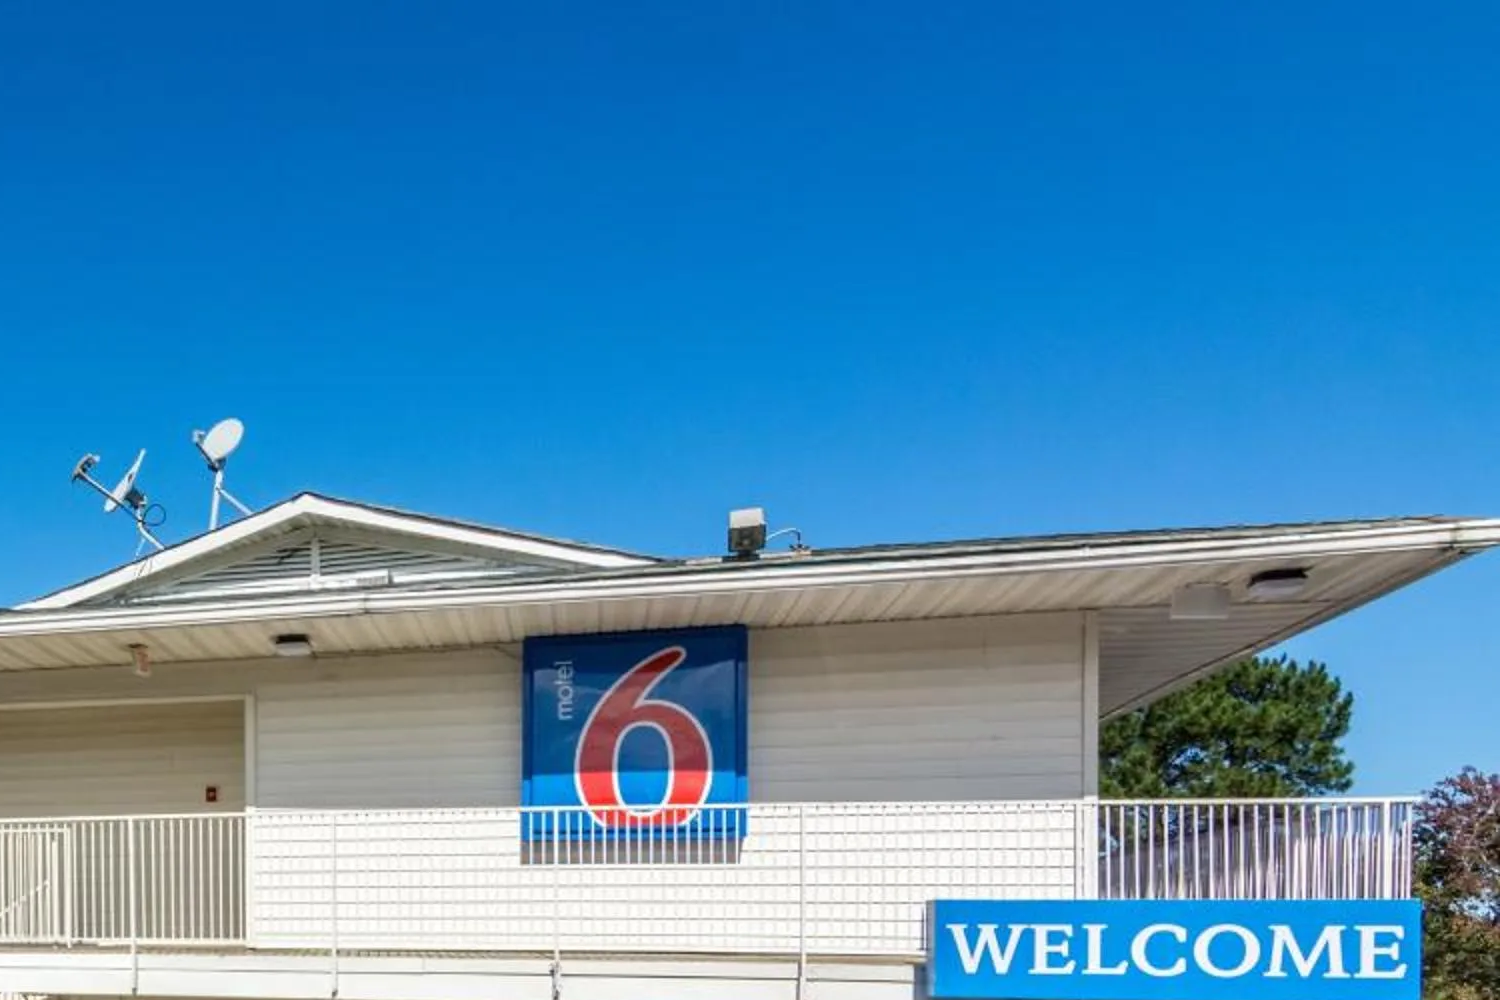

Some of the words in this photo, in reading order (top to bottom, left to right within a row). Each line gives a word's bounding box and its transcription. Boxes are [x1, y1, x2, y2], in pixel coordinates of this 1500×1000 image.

[555, 661, 573, 720] motel
[574, 646, 713, 830] 6
[947, 922, 1408, 979] WELCOME
